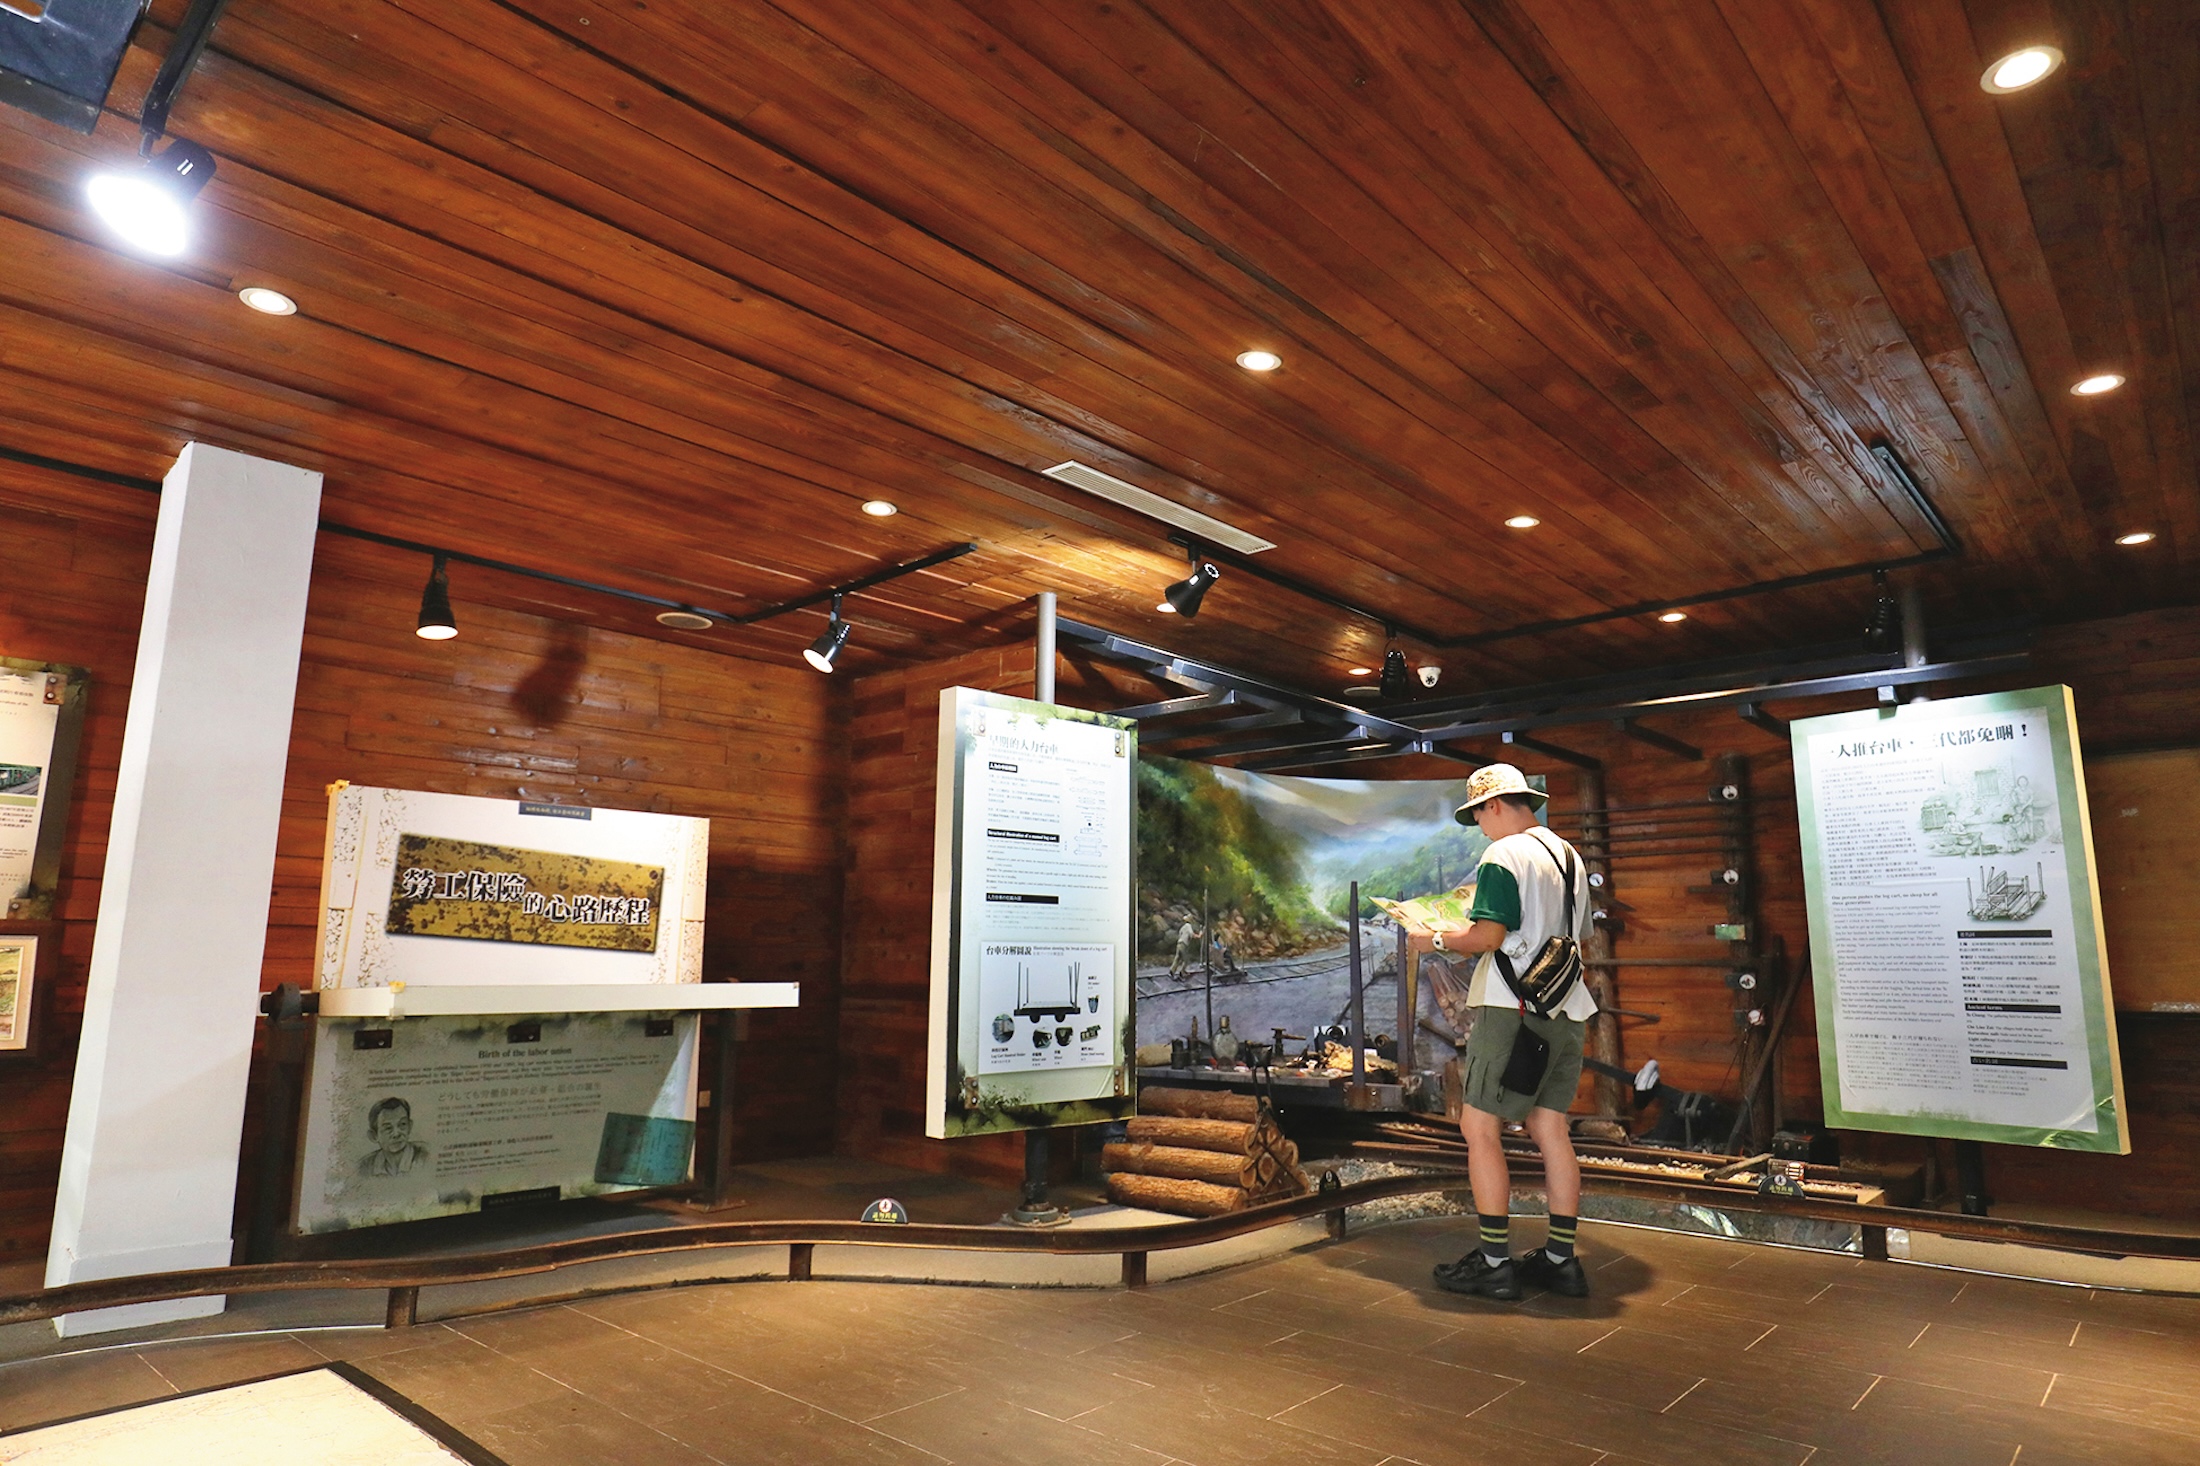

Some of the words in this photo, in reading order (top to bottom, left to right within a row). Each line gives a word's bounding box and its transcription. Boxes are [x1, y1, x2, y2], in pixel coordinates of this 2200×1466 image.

[402, 868, 652, 926] 勞工保險的心路歷程
[478, 1050, 500, 1059] Birth
[502, 1049, 510, 1057] of
[512, 1049, 525, 1057] the
[528, 1048, 548, 1056] labor
